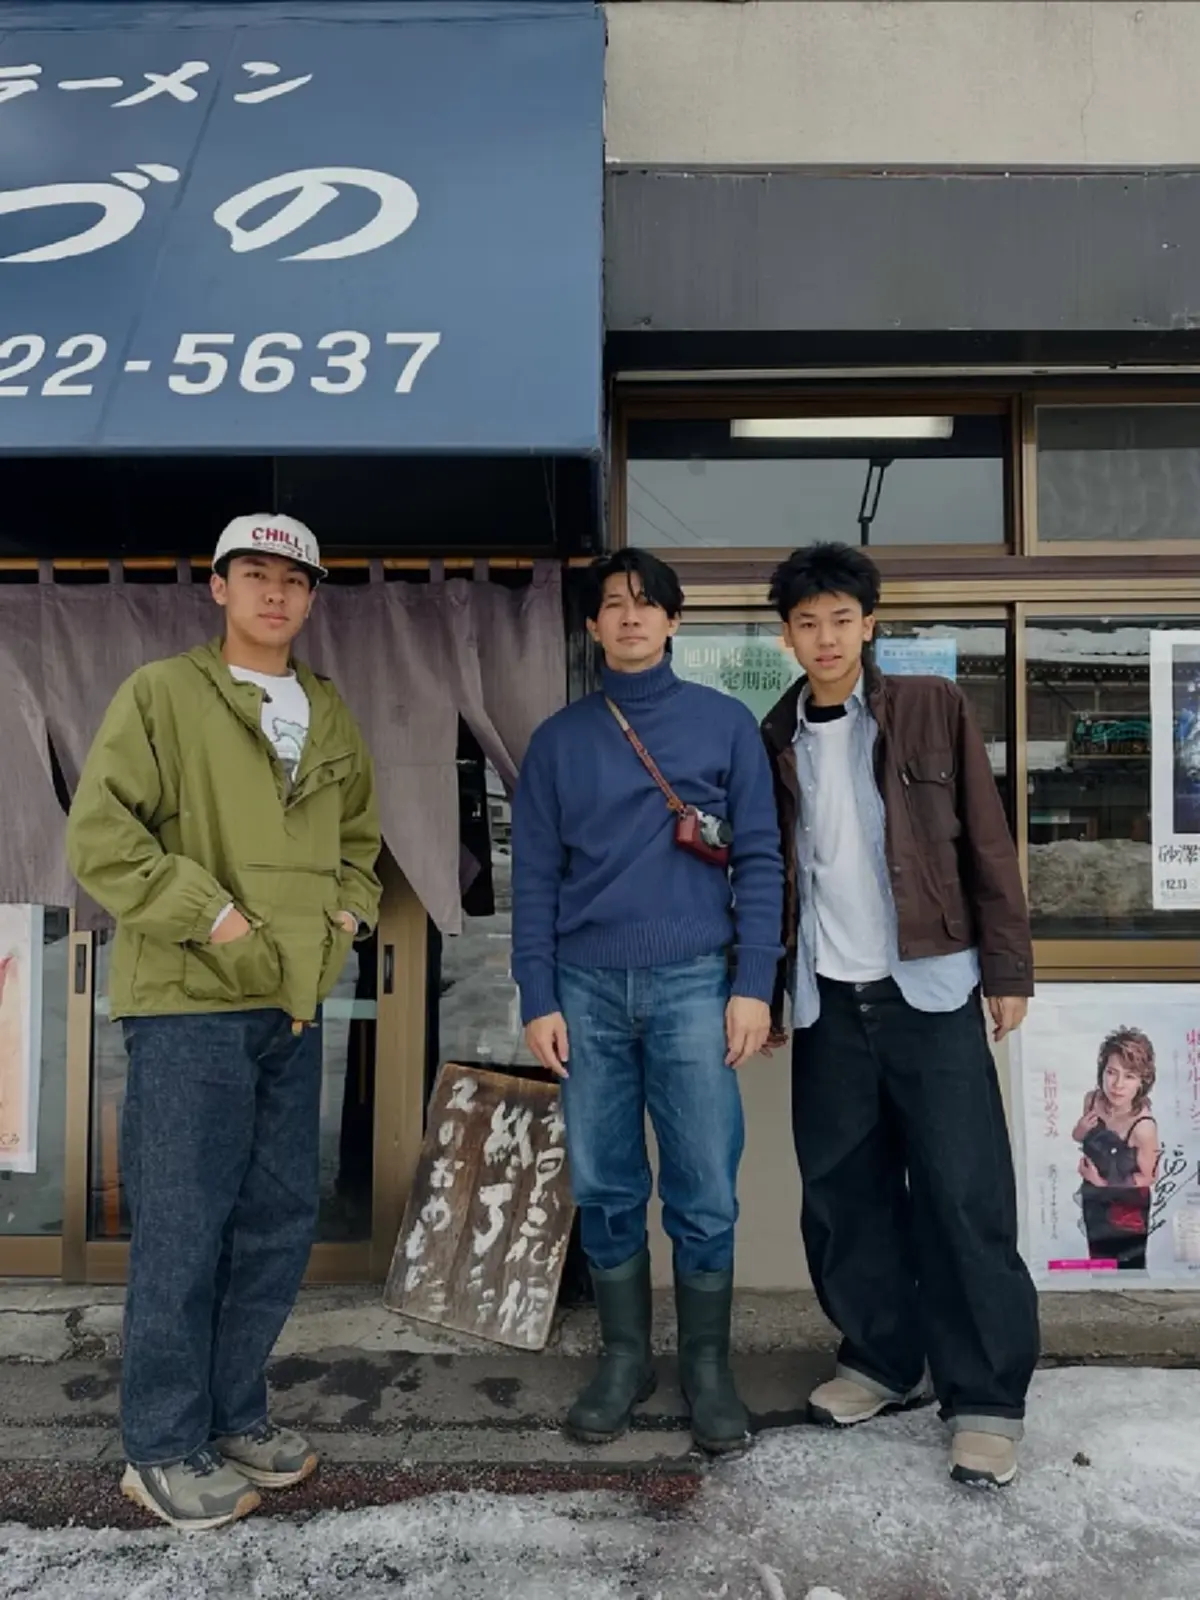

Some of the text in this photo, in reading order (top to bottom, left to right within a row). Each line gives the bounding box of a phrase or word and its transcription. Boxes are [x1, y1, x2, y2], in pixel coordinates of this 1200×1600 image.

[0, 61, 312, 107] ラーメン
[0, 330, 441, 396] 22-5637
[252, 527, 300, 549] CHILL
[719, 669, 793, 691] 定期演
